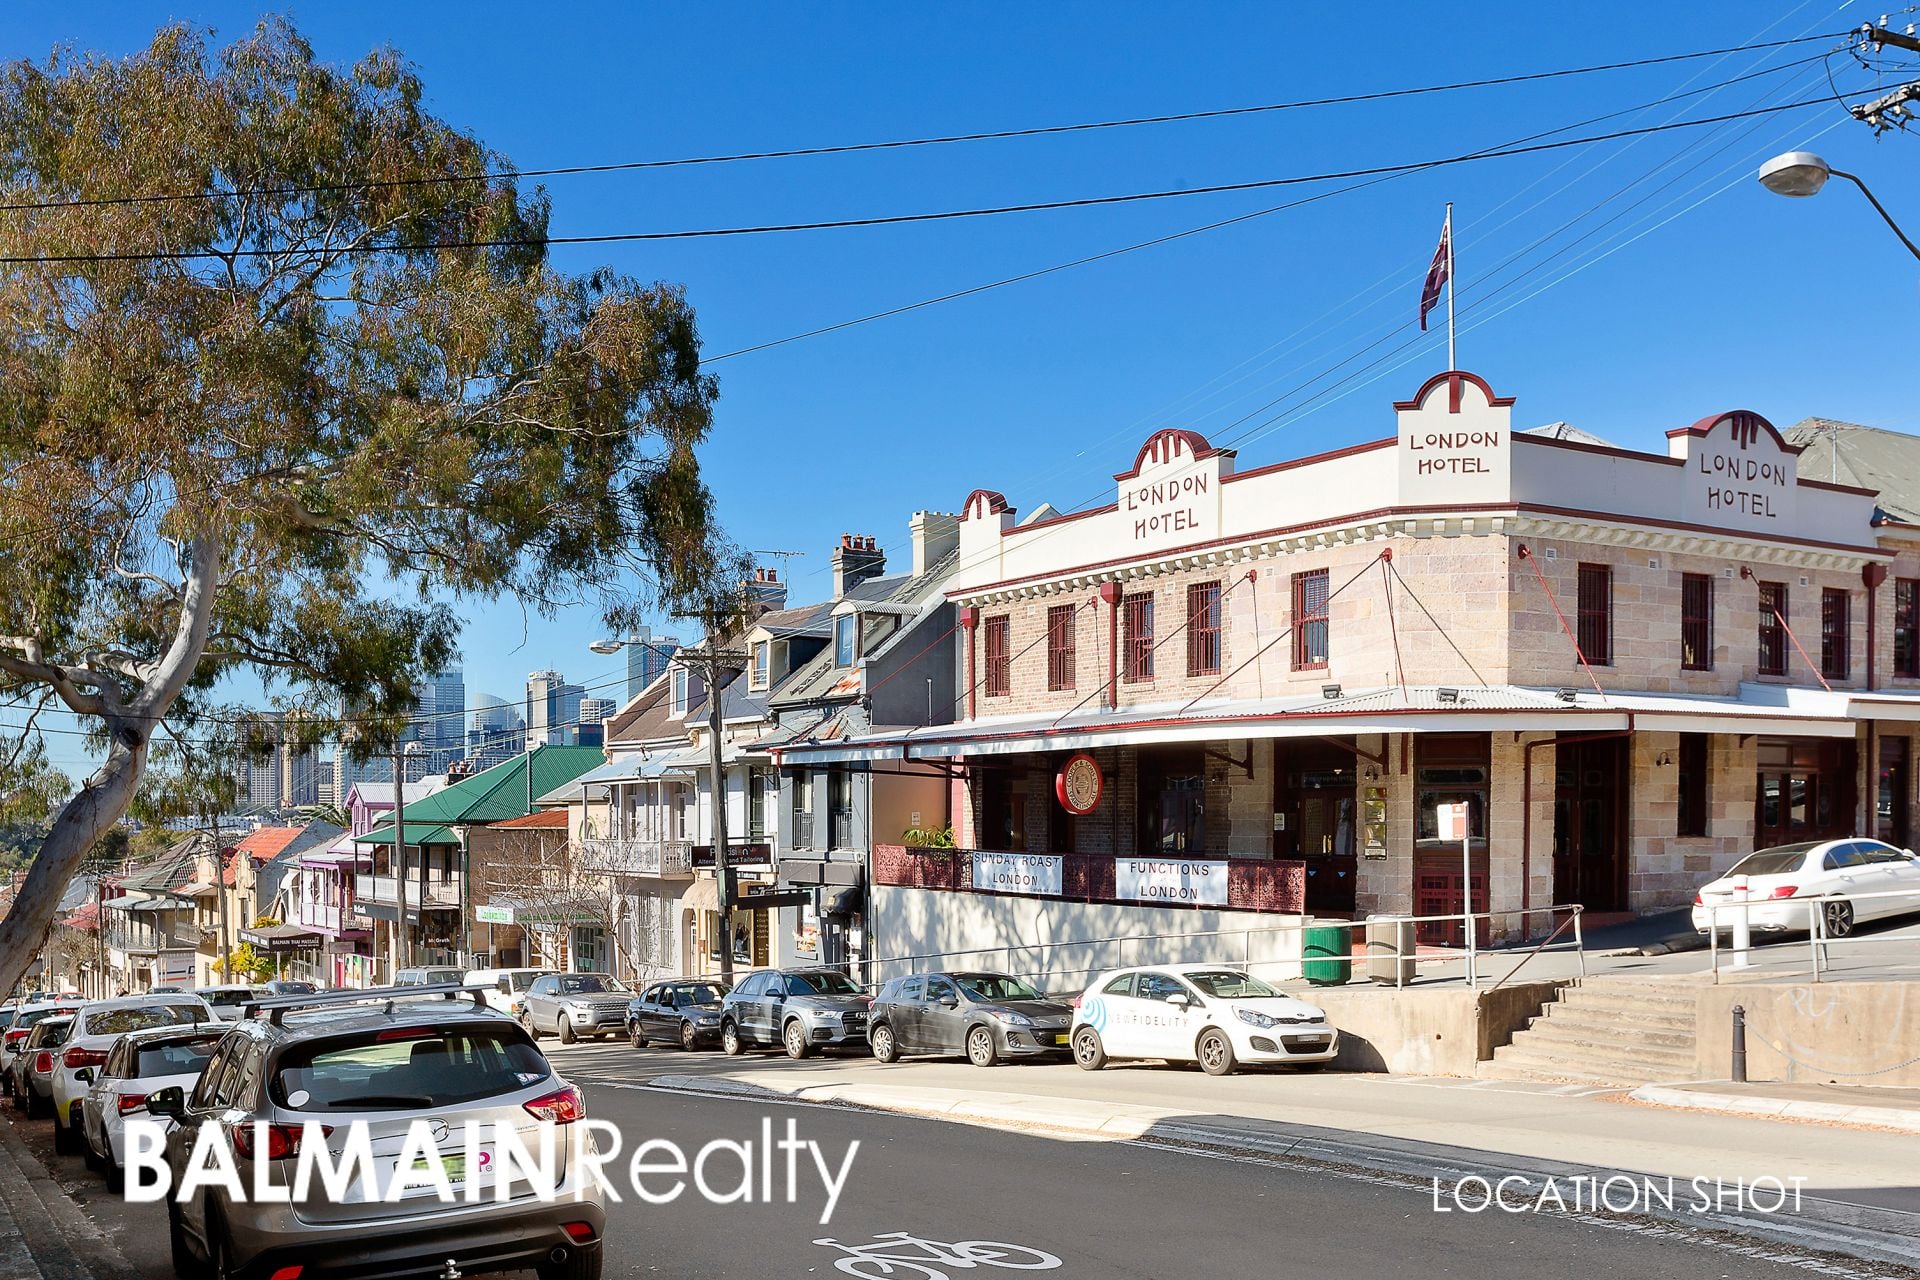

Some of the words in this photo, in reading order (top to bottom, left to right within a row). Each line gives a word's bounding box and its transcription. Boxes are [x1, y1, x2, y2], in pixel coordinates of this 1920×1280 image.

[1410, 431, 1498, 450] LONDON
[1418, 457, 1490, 475] HOTEL
[1700, 453, 1785, 487] LONDON
[1128, 472, 1207, 511] LONDON
[1708, 486, 1777, 518] HOTEL
[1135, 508, 1199, 540] HOTEL
[974, 852, 1017, 865] SUNDAY
[1021, 856, 1060, 868] ROAST
[1130, 861, 1209, 876] FUNCTIONS
[993, 872, 1038, 886] LONDON
[1140, 885, 1198, 900] LONDON
